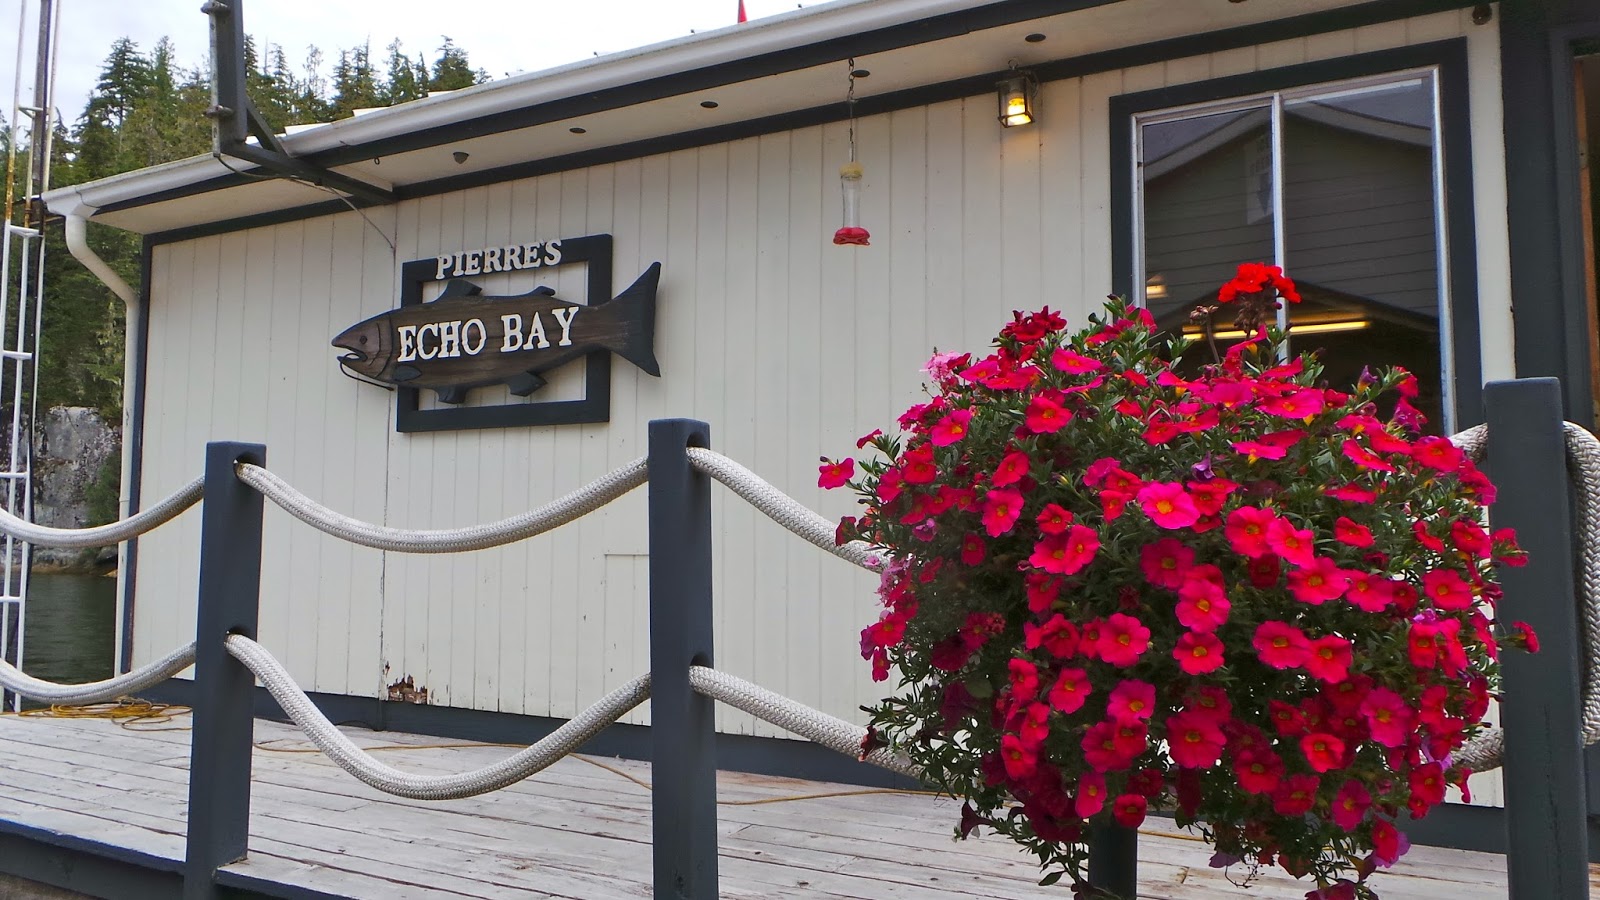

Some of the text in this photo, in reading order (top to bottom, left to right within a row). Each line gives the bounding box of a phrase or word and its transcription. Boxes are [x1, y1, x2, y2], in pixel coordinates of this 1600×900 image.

[435, 238, 563, 280] PIERRE'S
[397, 306, 579, 362] ECHO BAY
